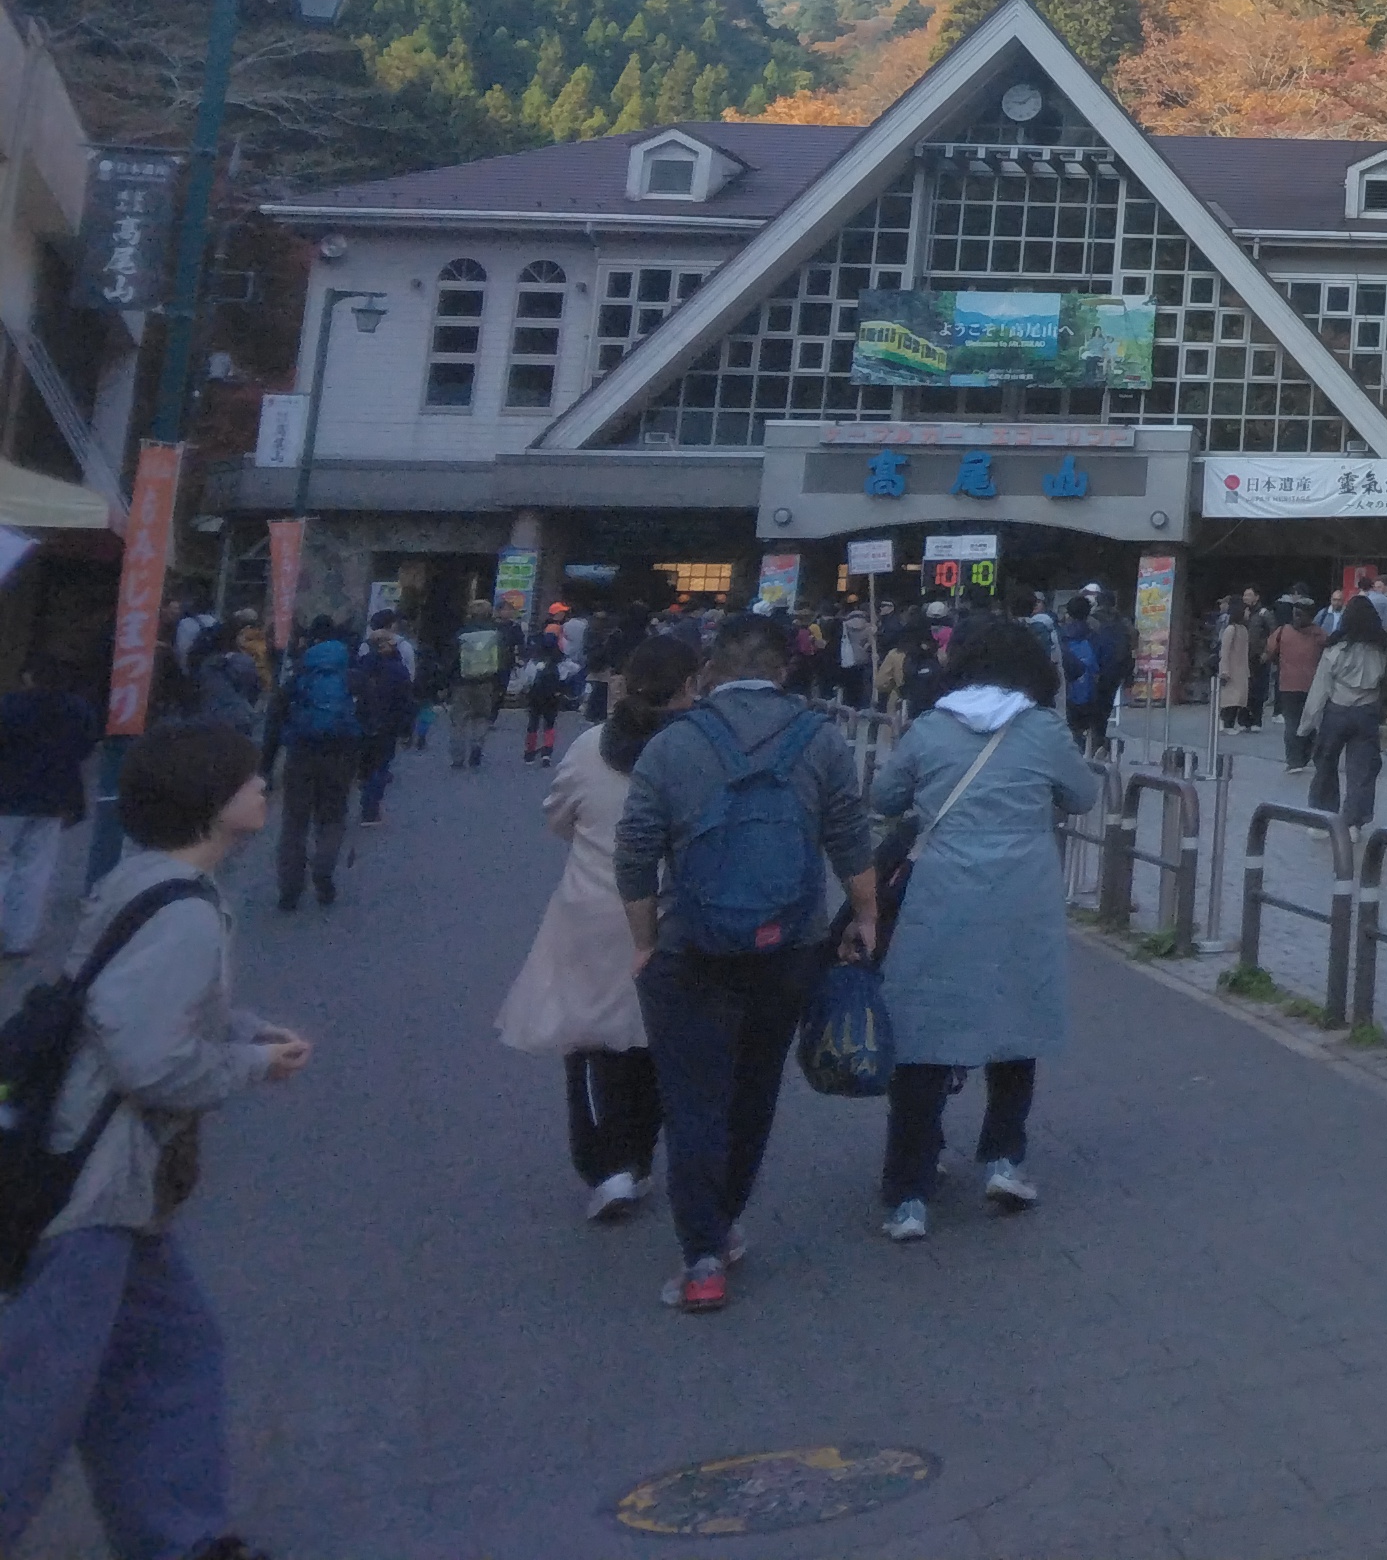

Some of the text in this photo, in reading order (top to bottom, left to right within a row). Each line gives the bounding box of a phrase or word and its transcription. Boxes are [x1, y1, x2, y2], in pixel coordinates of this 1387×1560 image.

[103, 214, 142, 304] 高尾山
[862, 448, 1090, 497] 高尾山
[1246, 477, 1312, 493] 日本遺産
